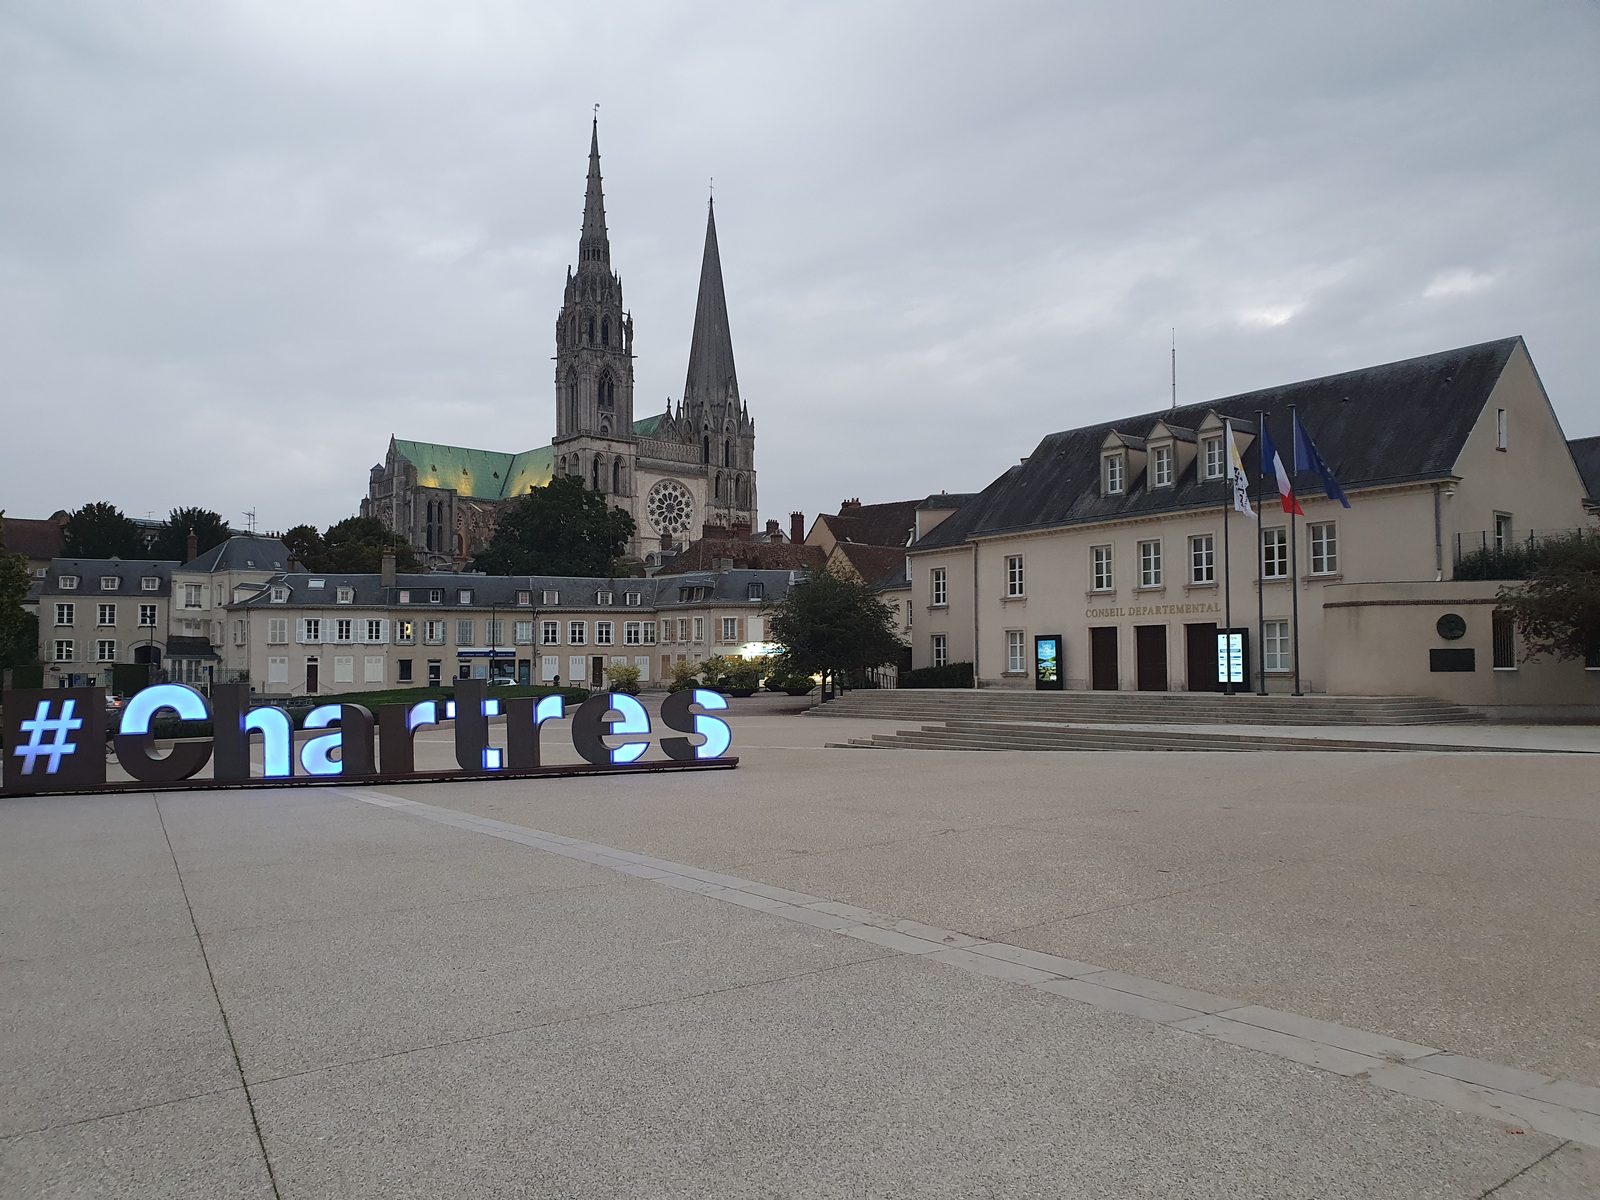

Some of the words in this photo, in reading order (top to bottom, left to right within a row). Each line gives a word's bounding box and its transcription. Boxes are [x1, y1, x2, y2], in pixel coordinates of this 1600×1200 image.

[1085, 607, 1126, 618] CONSEIL
[1128, 602, 1221, 617] DEPARTEMENTAL
[13, 679, 732, 782] #Chartres
